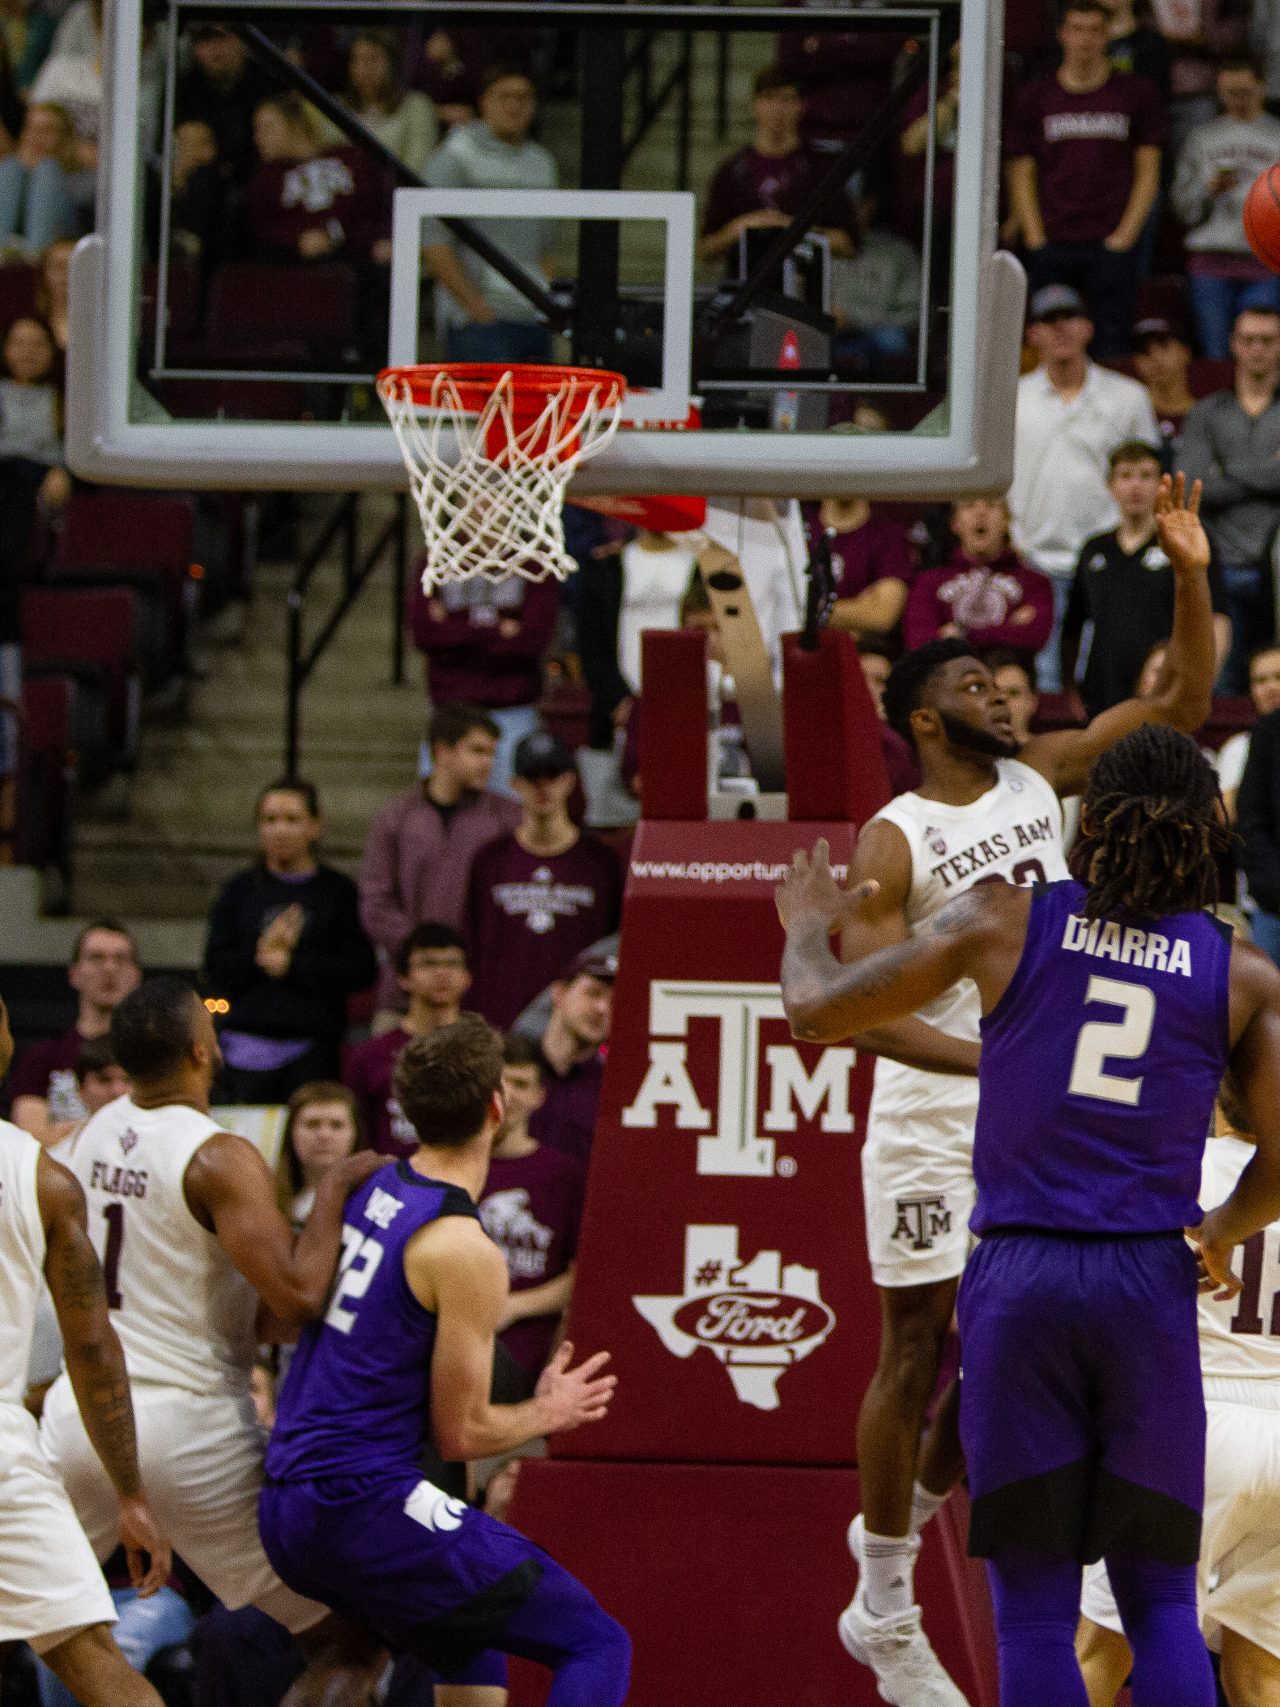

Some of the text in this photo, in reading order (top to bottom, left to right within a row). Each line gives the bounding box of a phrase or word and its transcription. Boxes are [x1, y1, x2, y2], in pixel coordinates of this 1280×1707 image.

[931, 833, 1010, 888] TEXAS
[1061, 914, 1192, 977] DIARRA
[1067, 974, 1157, 1107] 2
[90, 1161, 148, 1199] FLAGG
[103, 1203, 124, 1310] 1
[696, 1295, 806, 1341] Ford
